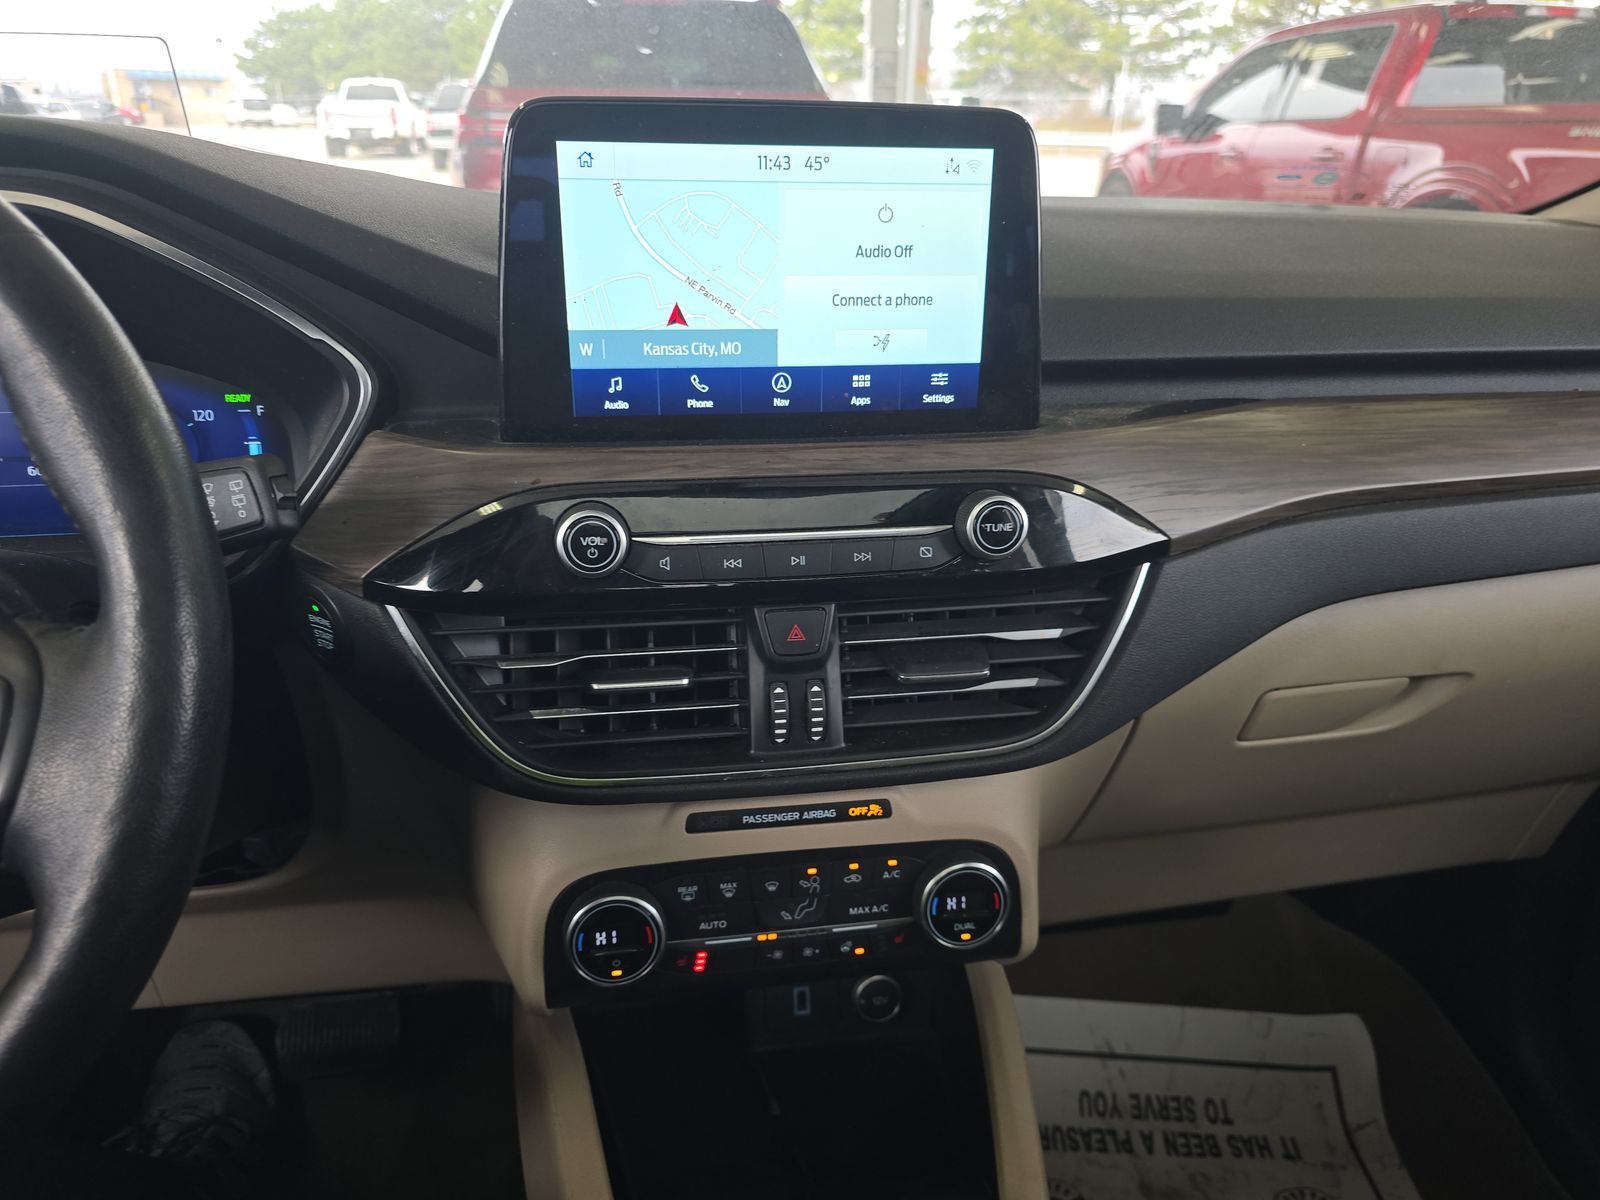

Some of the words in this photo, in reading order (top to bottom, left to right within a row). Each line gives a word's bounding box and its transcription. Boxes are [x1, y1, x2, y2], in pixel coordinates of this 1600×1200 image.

[757, 155, 791, 170] 11:43
[804, 155, 830, 171] 45°
[612, 181, 623, 197] Rd
[855, 244, 892, 259] Audio
[894, 244, 914, 259] Off
[684, 276, 700, 291] NE
[697, 284, 728, 310] Parvin
[723, 302, 736, 315] Rd
[832, 293, 883, 307] Connect
[883, 296, 893, 307] a
[894, 293, 934, 311] phone
[579, 343, 594, 356] W
[643, 342, 689, 356] Kansas
[691, 342, 718, 358] City,
[720, 342, 742, 355] MO
[224, 393, 252, 403] READY
[687, 398, 714, 409] Phone
[773, 397, 789, 407] Nav
[850, 396, 871, 407] Apps
[922, 393, 954, 404] Settings
[256, 404, 265, 417] F
[604, 400, 629, 410] Audio
[191, 409, 215, 422] 120
[985, 522, 1014, 532] TUNE
[579, 536, 606, 546] VOL
[742, 810, 799, 824] PASSENGER
[802, 808, 836, 820] AIRBAG
[848, 806, 868, 817] OFF
[883, 870, 900, 879] A/C
[678, 885, 698, 896] REAR
[849, 906, 870, 916] MAX
[871, 904, 888, 914] A/C
[699, 920, 727, 930] AUTO
[954, 922, 975, 931] DUAL
[1079, 1089, 1123, 1118] YOU
[1130, 1093, 1196, 1124] SERVE
[1204, 1097, 1234, 1125] TO
[1040, 1124, 1134, 1153] PLEASUR
[1139, 1129, 1155, 1155] A
[1162, 1130, 1223, 1158] BEEN
[1226, 1133, 1273, 1159] HAS
[1281, 1137, 1303, 1160] IT
